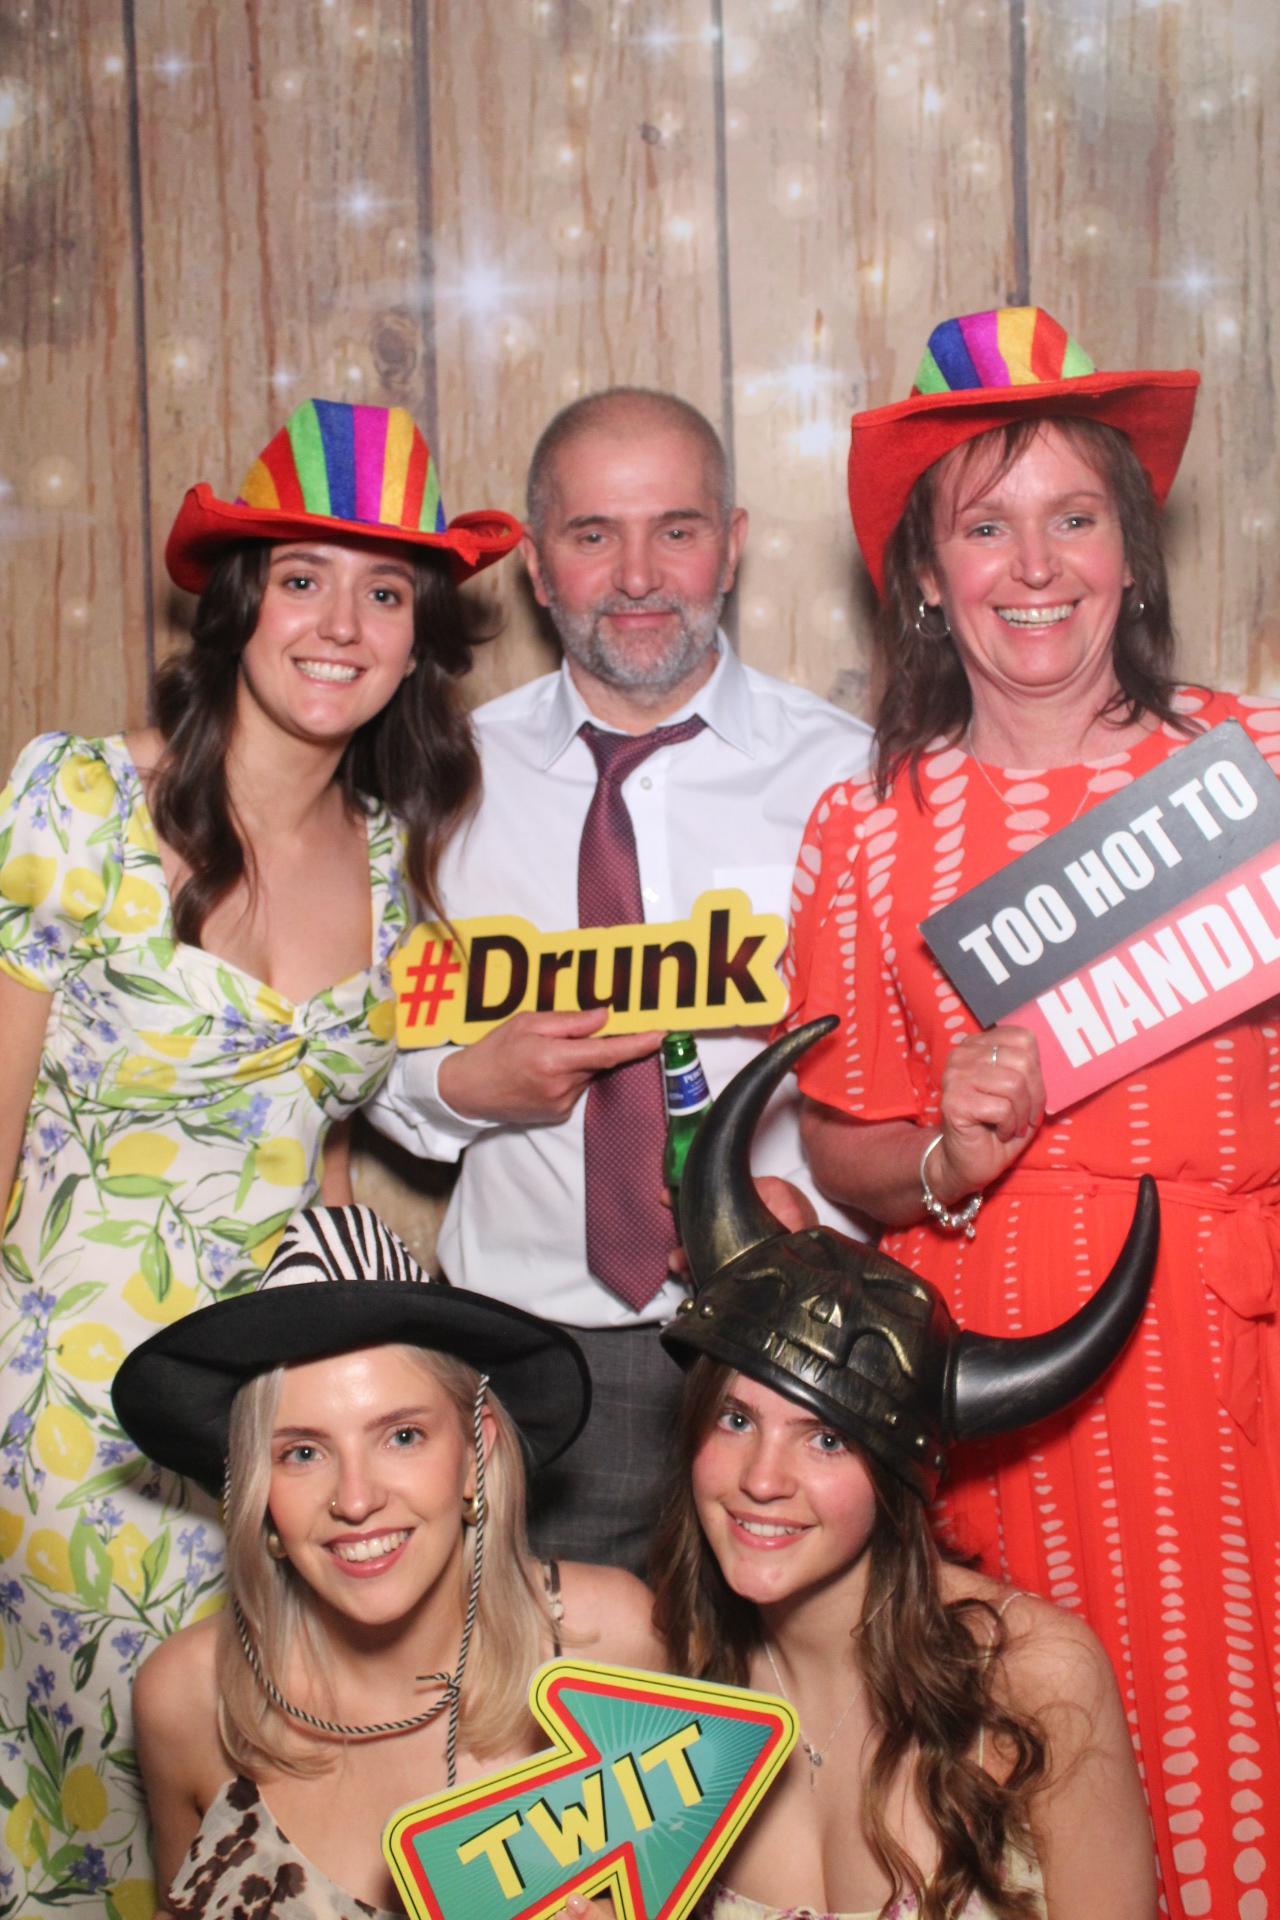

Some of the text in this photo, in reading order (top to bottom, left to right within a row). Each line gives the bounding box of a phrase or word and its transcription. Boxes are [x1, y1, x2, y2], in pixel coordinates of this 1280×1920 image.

[958, 760, 1258, 986] TOO HOT TO
[400, 908, 768, 1027] #Drunk
[456, 1720, 704, 1899] TWIT
